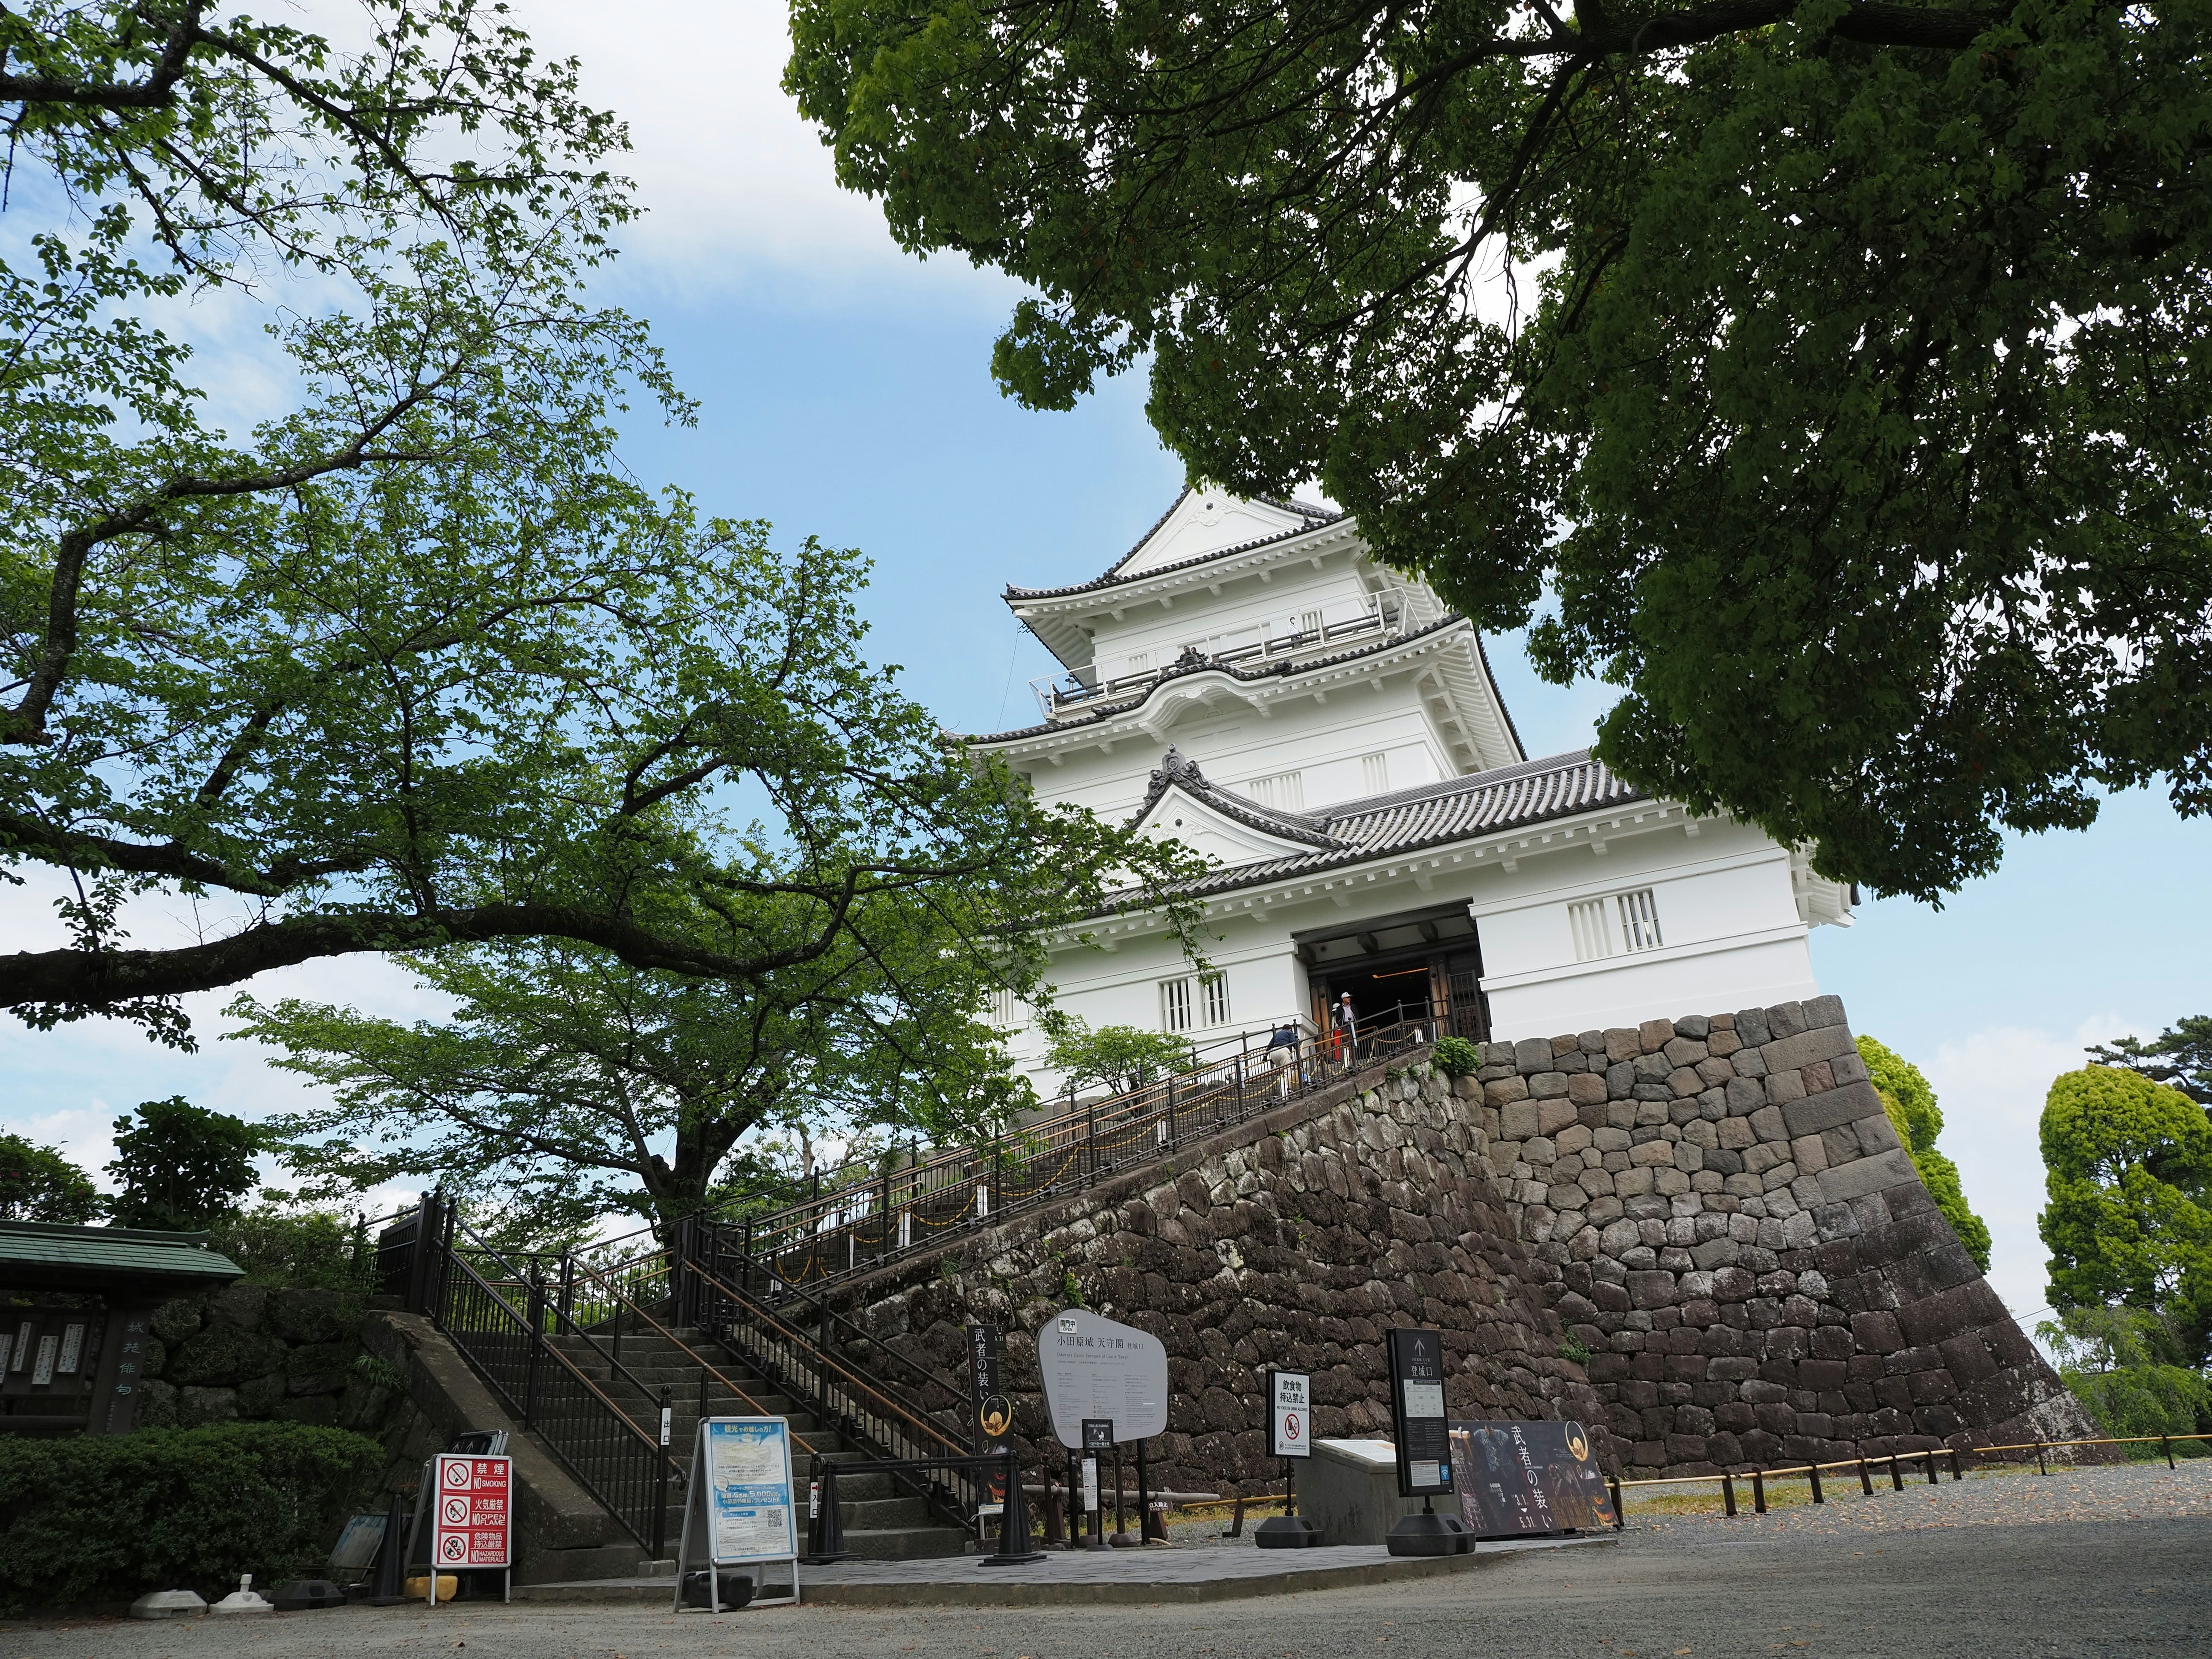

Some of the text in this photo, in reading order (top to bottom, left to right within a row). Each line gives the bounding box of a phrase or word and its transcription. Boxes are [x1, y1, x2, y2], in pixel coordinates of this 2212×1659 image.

[1060, 1319, 1075, 1327] 開門中
[1057, 1336, 1094, 1347] 小田原城
[1098, 1338, 1123, 1348] 天守閣
[115, 1321, 144, 1395] 城苑俳句
[975, 1328, 989, 1400] 武者の装い
[1411, 1365, 1432, 1377] 登城口
[1283, 1380, 1301, 1391] 飲食物
[1280, 1391, 1305, 1403] 持込禁止
[664, 1420, 669, 1442] 出口
[477, 1463, 504, 1475] 禁煙
[1511, 1425, 1552, 1528] 武者の装い
[474, 1477, 481, 1489] NO
[475, 1499, 503, 1511] 火気厳禁
[813, 1495, 818, 1516] 入口
[472, 1513, 480, 1525] NO
[474, 1532, 502, 1540] 危険物品
[471, 1550, 479, 1563] NO
